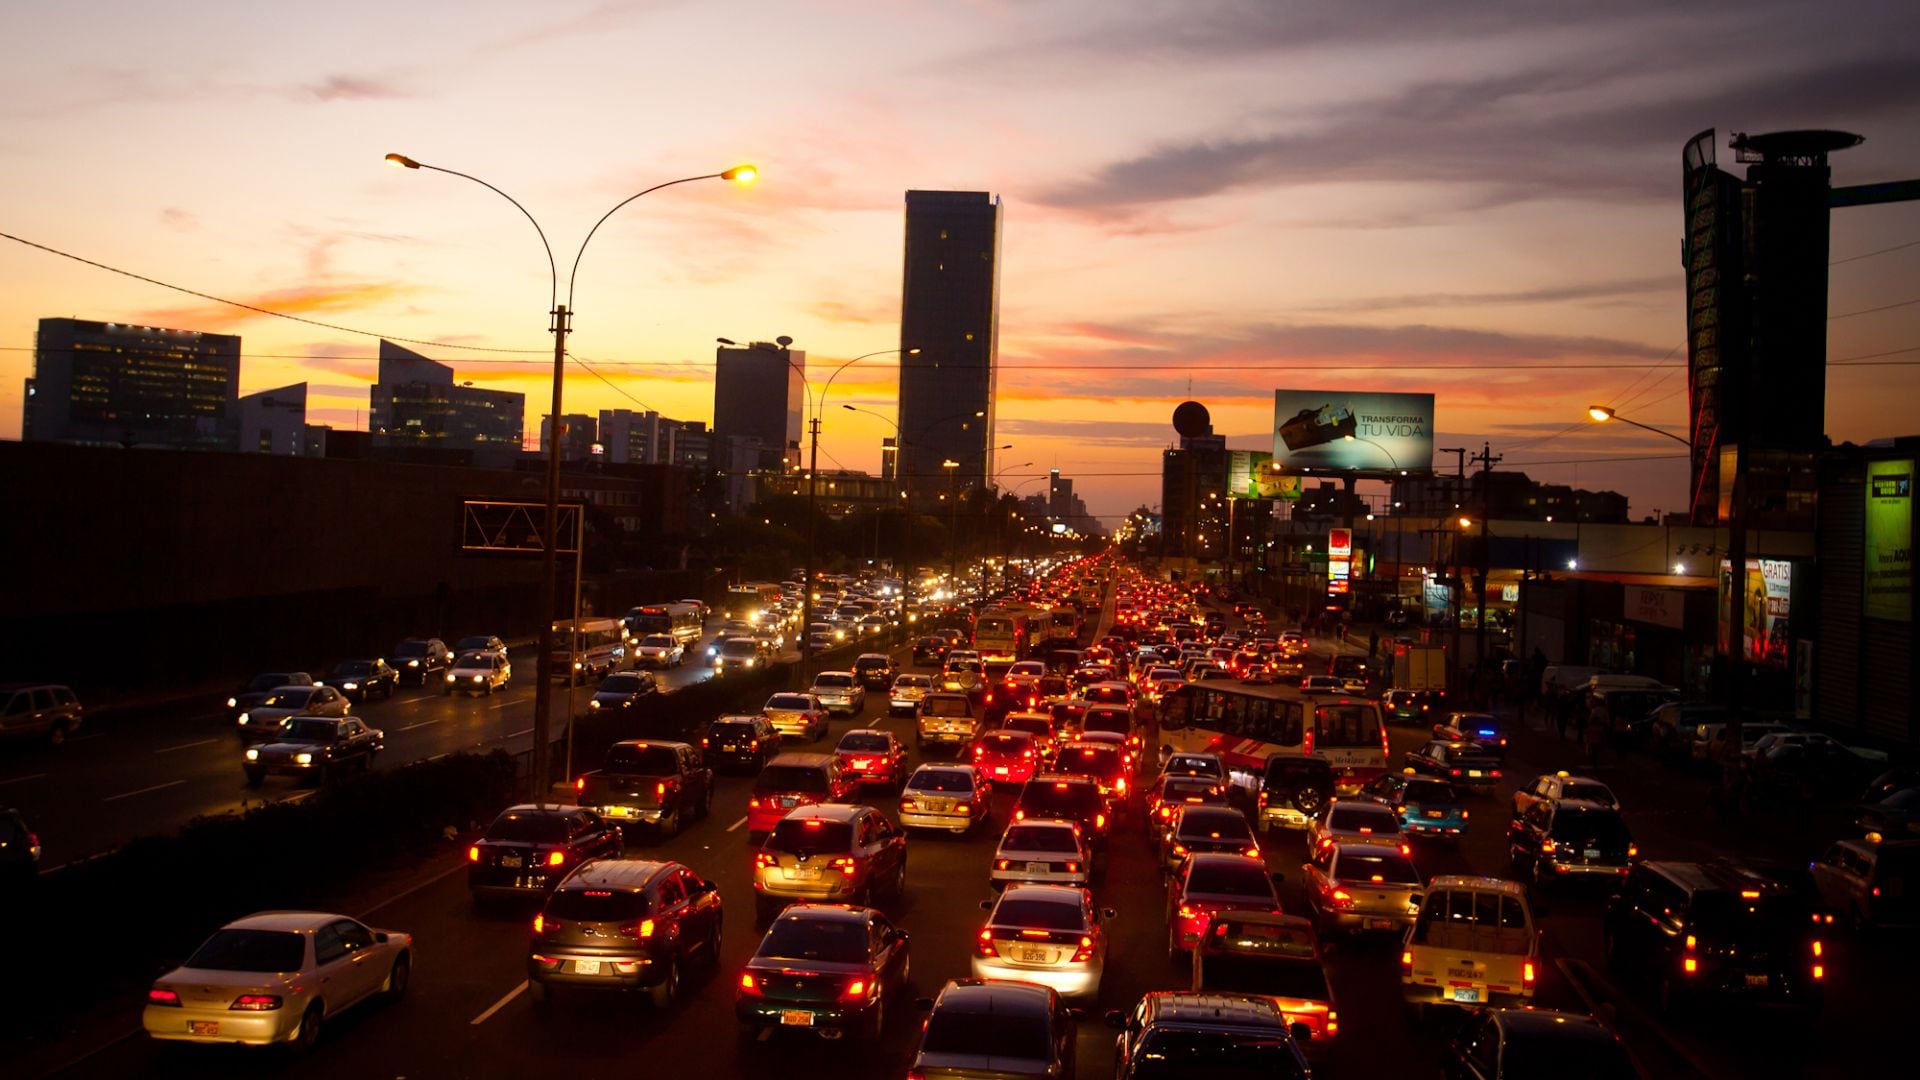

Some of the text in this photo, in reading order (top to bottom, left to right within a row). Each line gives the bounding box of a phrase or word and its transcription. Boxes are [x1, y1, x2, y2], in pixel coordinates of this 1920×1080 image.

[1361, 415, 1424, 424] TRANSFORMA
[1361, 424, 1424, 437] TU VIDA
[1764, 563, 1790, 580] GRATIS!
